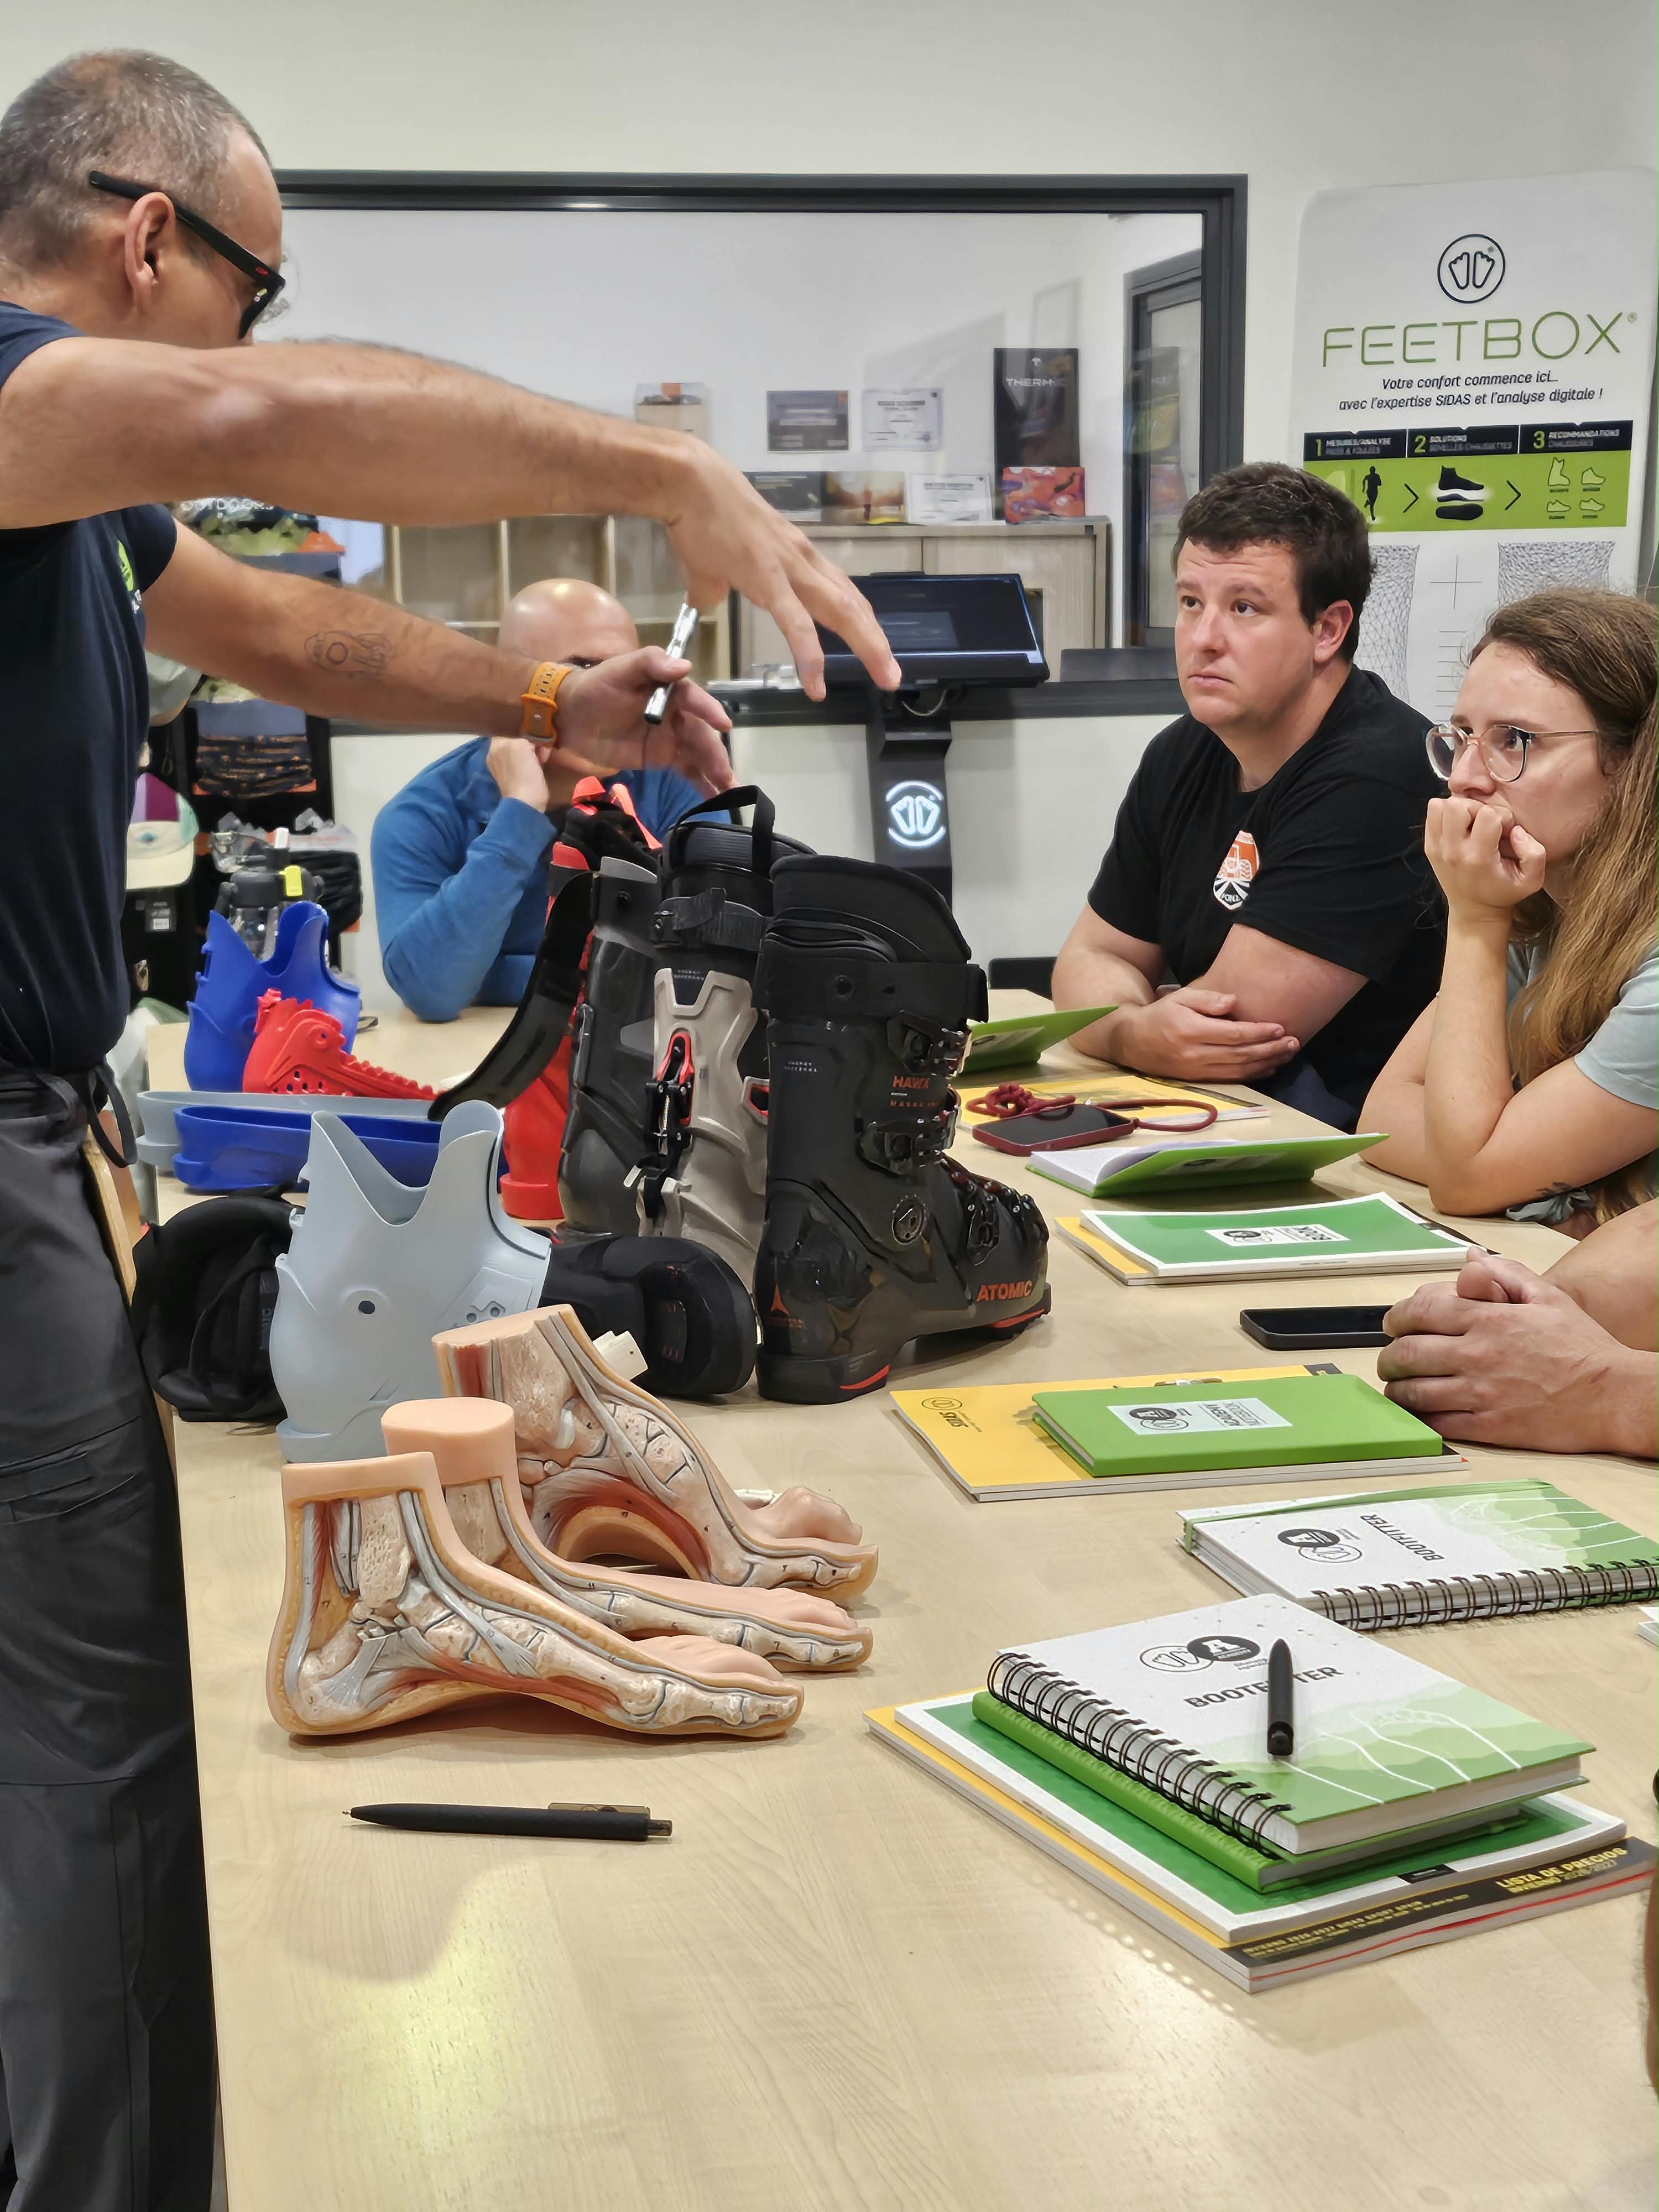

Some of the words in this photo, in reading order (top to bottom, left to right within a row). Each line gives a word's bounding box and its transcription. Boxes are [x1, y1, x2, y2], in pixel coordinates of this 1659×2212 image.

[1322, 311, 1624, 367] FEETBOX
[1382, 378, 1413, 389] Votre
[1417, 375, 1461, 390] confort
[1464, 373, 1532, 386] commence
[1339, 399, 1368, 410] avec
[1370, 396, 1432, 410] l'expertise
[1436, 394, 1471, 406] SIDAS
[1474, 393, 1487, 405] et
[1490, 390, 1545, 404] l'analyse
[1549, 388, 1595, 403] digitale
[1598, 388, 1603, 399] !
[1316, 439, 1322, 456] 1
[1414, 435, 1427, 453] 2
[1533, 430, 1546, 449] 3
[892, 1076, 930, 1089] HAWX
[976, 1280, 1032, 1301] ATOMIC
[1360, 1514, 1445, 1561] BOOTFITTER
[774, 1641, 780, 1651] 7
[1183, 1666, 1345, 1708] BOOTFTER
[1495, 1874, 1542, 1888] LISTA
[1538, 1867, 1564, 1877] DE
[1561, 1848, 1628, 1872] PRECIOS
